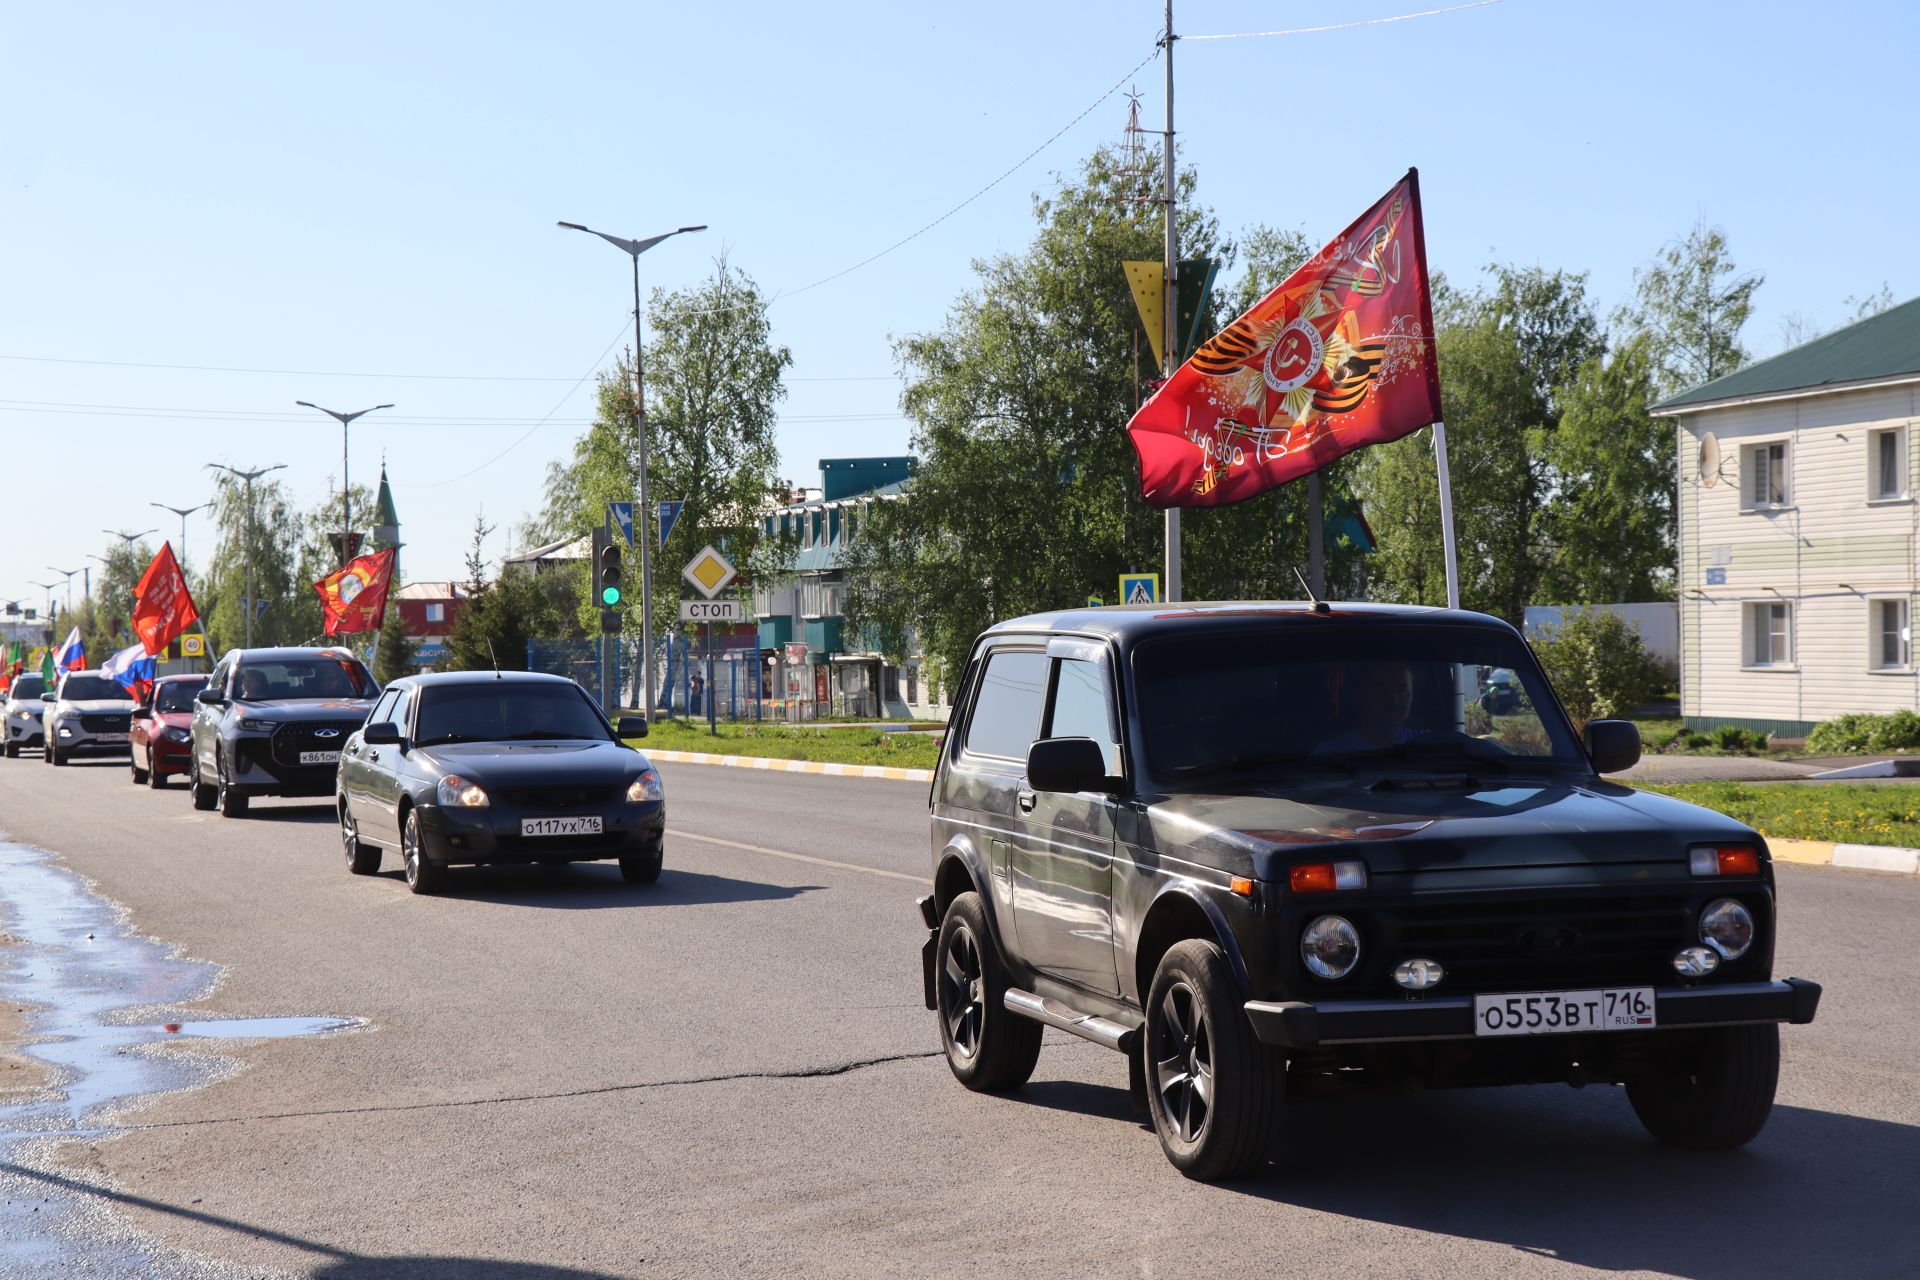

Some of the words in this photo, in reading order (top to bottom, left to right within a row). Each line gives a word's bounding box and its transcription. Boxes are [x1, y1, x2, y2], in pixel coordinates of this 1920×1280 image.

[690, 604, 732, 617] СТОП
[187, 640, 198, 649] 40
[525, 820, 577, 834] О117УХ
[579, 818, 599, 829] 716
[1485, 996, 1599, 1030] О553ВТ
[1604, 991, 1647, 1017] 716
[1615, 1016, 1637, 1025] RUS
